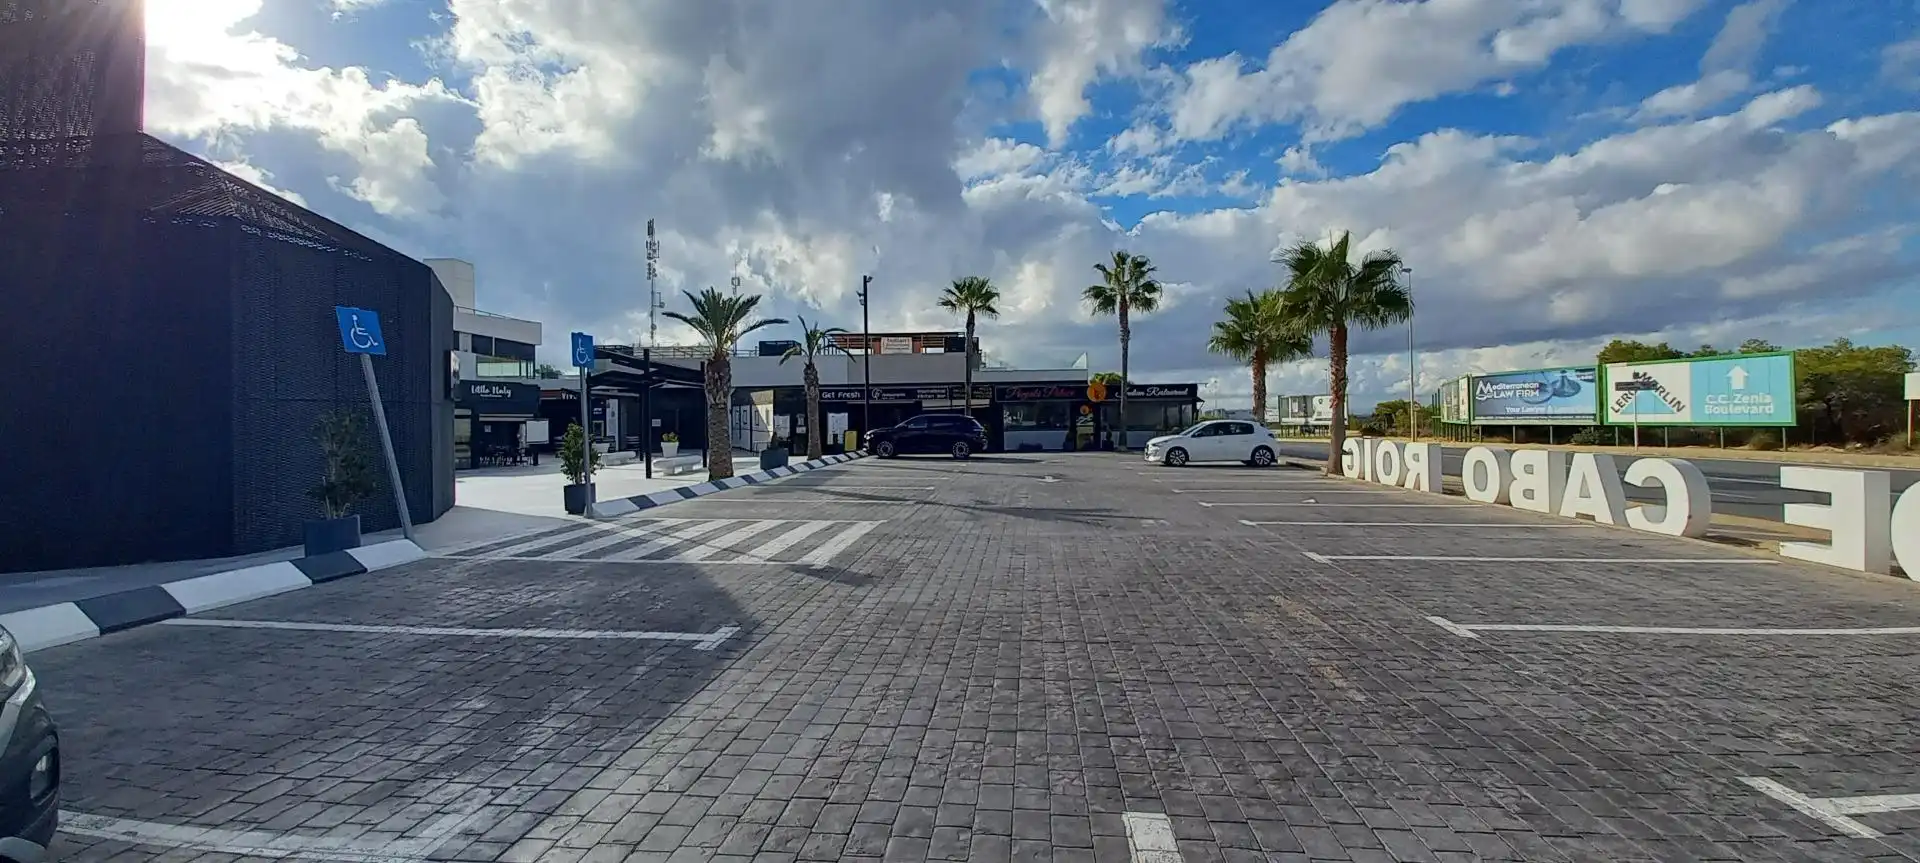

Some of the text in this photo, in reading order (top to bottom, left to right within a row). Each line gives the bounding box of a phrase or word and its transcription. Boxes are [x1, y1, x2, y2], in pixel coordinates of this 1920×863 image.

[1476, 379, 1540, 397] Mediterranean
[1494, 389, 1540, 399] LAW FIRM
[821, 391, 861, 399] Get Fresh
[1733, 392, 1772, 404] Zenia
[1704, 402, 1774, 414] Boulevard
